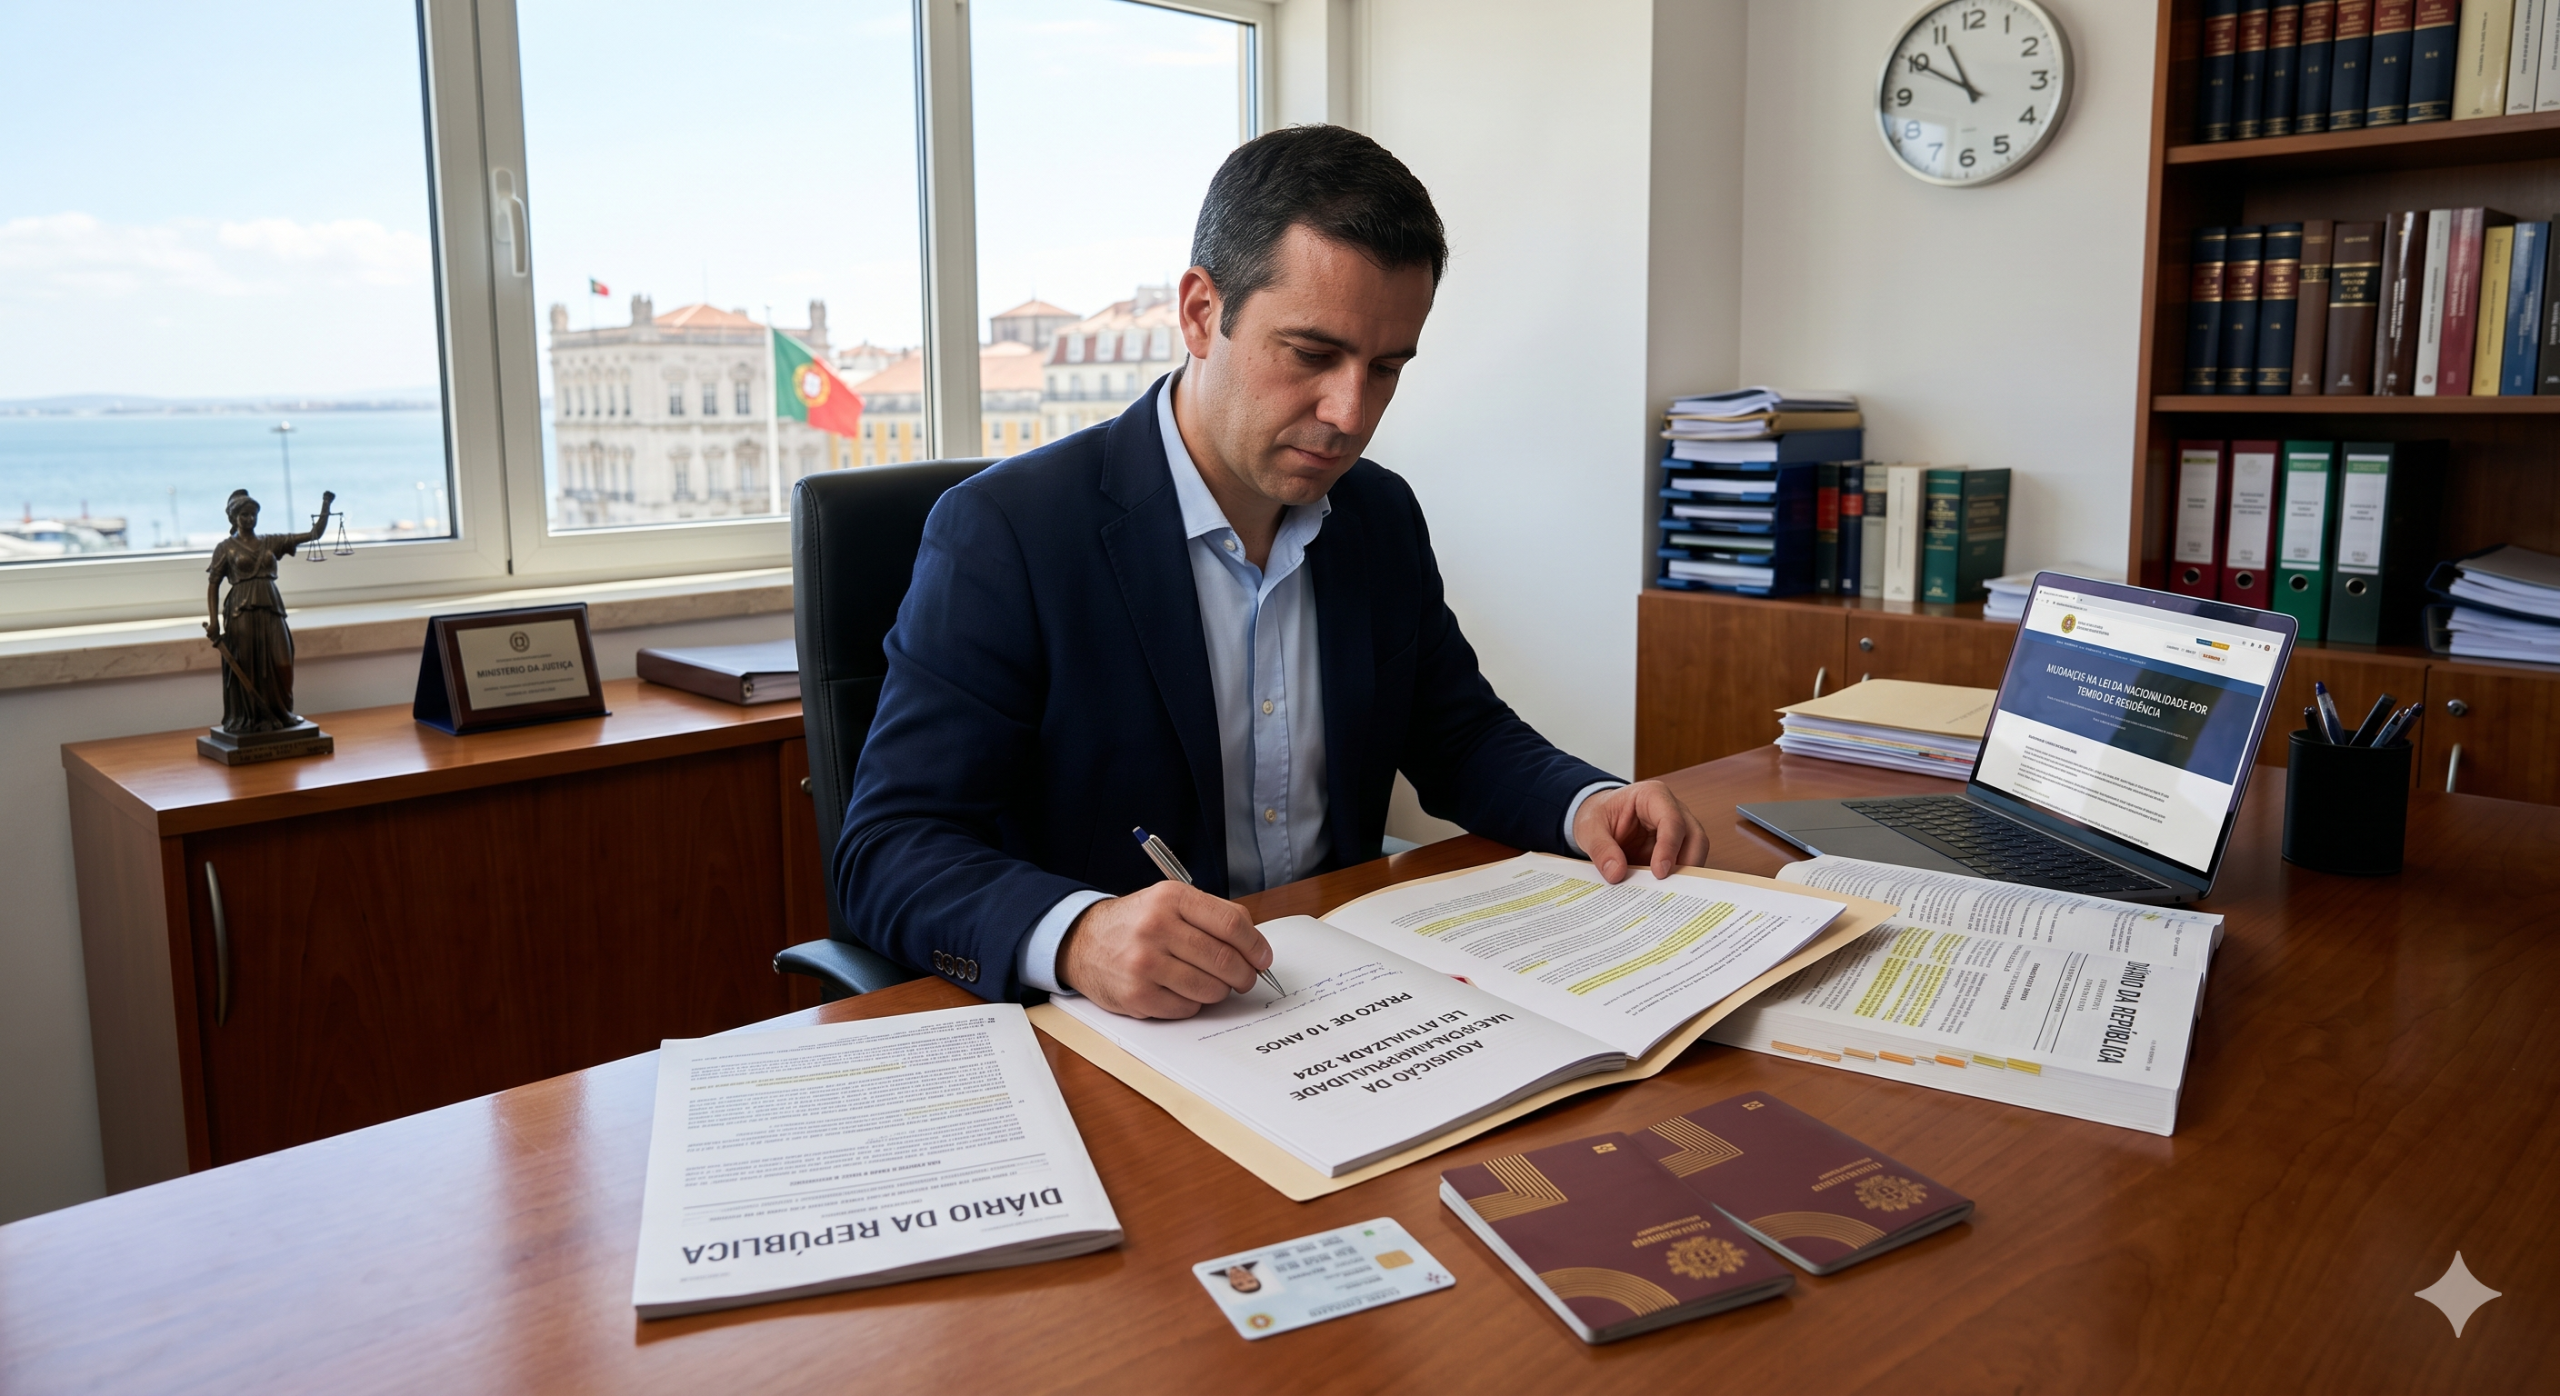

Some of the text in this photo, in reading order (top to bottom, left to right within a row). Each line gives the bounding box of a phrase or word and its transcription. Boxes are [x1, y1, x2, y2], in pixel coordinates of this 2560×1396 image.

[1962, 9, 1986, 30] 12
[2004, 14, 2011, 34] 1
[1934, 25, 1947, 45] 11
[2021, 36, 2039, 57] 2
[1908, 53, 1930, 73] 10
[2029, 69, 2048, 90] 3
[1896, 87, 1913, 107] 9
[2018, 105, 2037, 125] 4
[1904, 120, 1922, 140] 8
[1927, 142, 1944, 162] 7
[1992, 135, 2010, 154] 5
[1959, 148, 1976, 168] 6
[527, 662, 540, 673] DA
[2085, 674, 2097, 686] NA
[2098, 677, 2111, 689] LEI
[2111, 681, 2123, 693] DA
[2188, 701, 2208, 715] POR
[2103, 693, 2116, 705] DE
[2114, 989, 2141, 1003] DA
[1255, 992, 1413, 1054] PRAZO DE 10 ANOS
[1438, 1010, 1468, 1023] LEI
[1293, 1059, 1338, 1080] 2024
[1361, 1078, 1393, 1093] DA
[682, 1187, 1063, 1265] DIÁRIO DA REPÚBLICA
